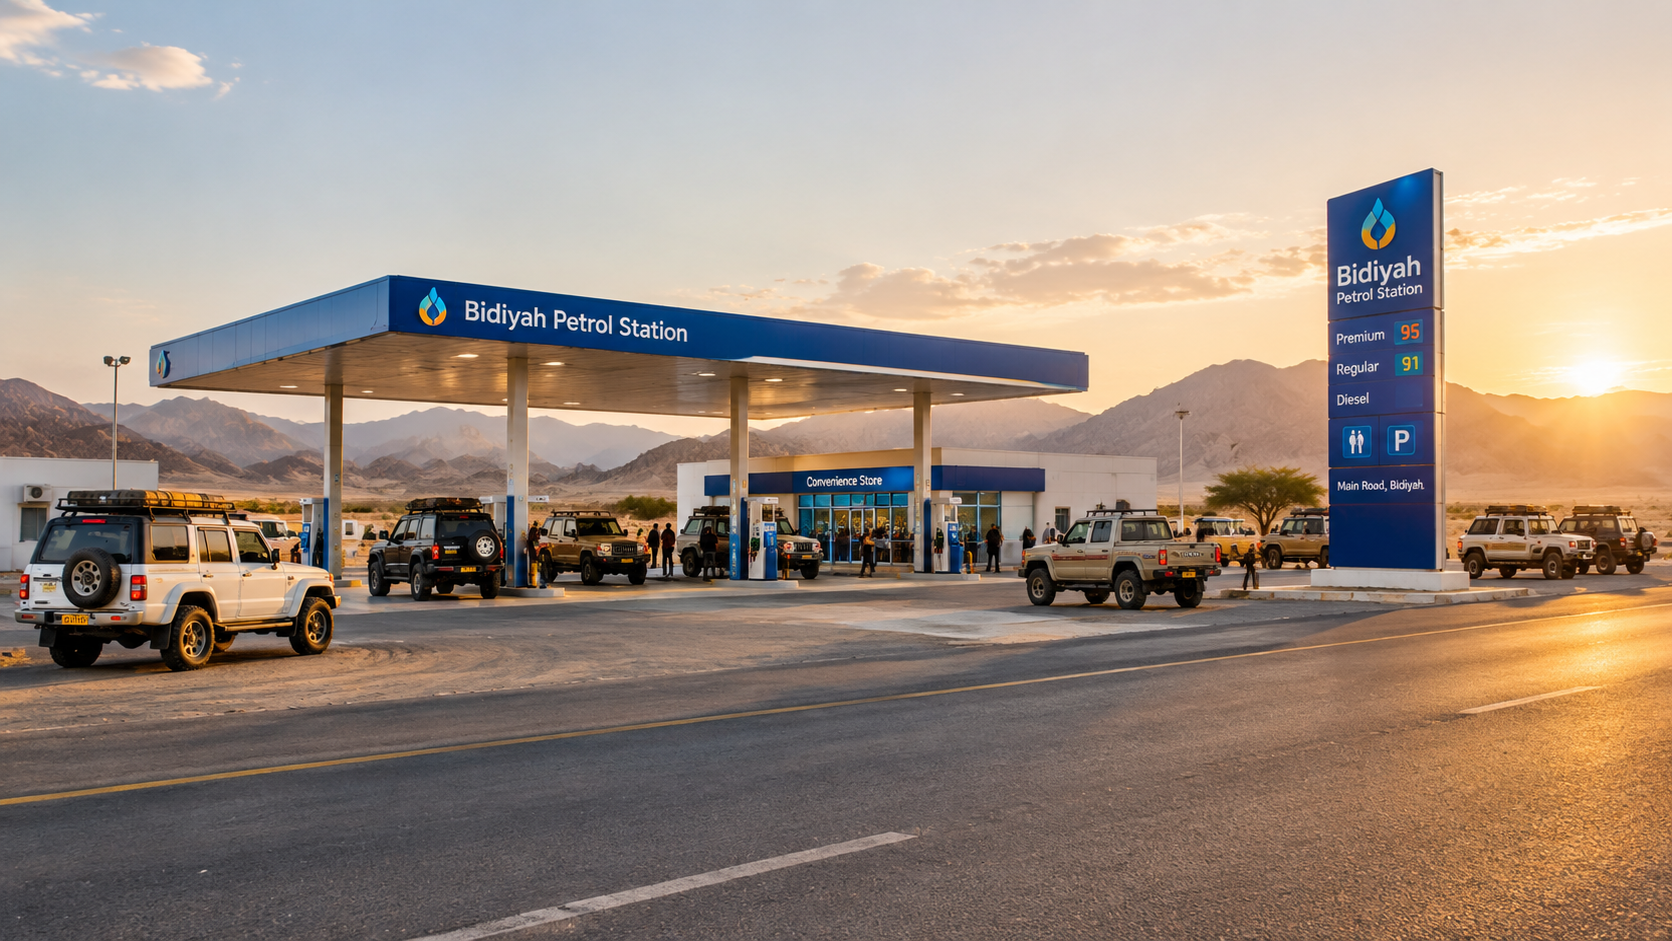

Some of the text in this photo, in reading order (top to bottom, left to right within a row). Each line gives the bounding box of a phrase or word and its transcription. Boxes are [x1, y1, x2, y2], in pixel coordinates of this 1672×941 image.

[1337, 255, 1421, 286] Bidiyah
[1337, 283, 1423, 305] Petrol Station
[465, 300, 689, 343] Bidiyah Petrol Station
[1336, 323, 1420, 346] Premium 95
[1336, 355, 1419, 377] Regular 91
[1336, 391, 1370, 406] Diesel
[1394, 429, 1410, 452] P
[806, 474, 883, 488] Convenience Store
[1337, 480, 1359, 491] Main
